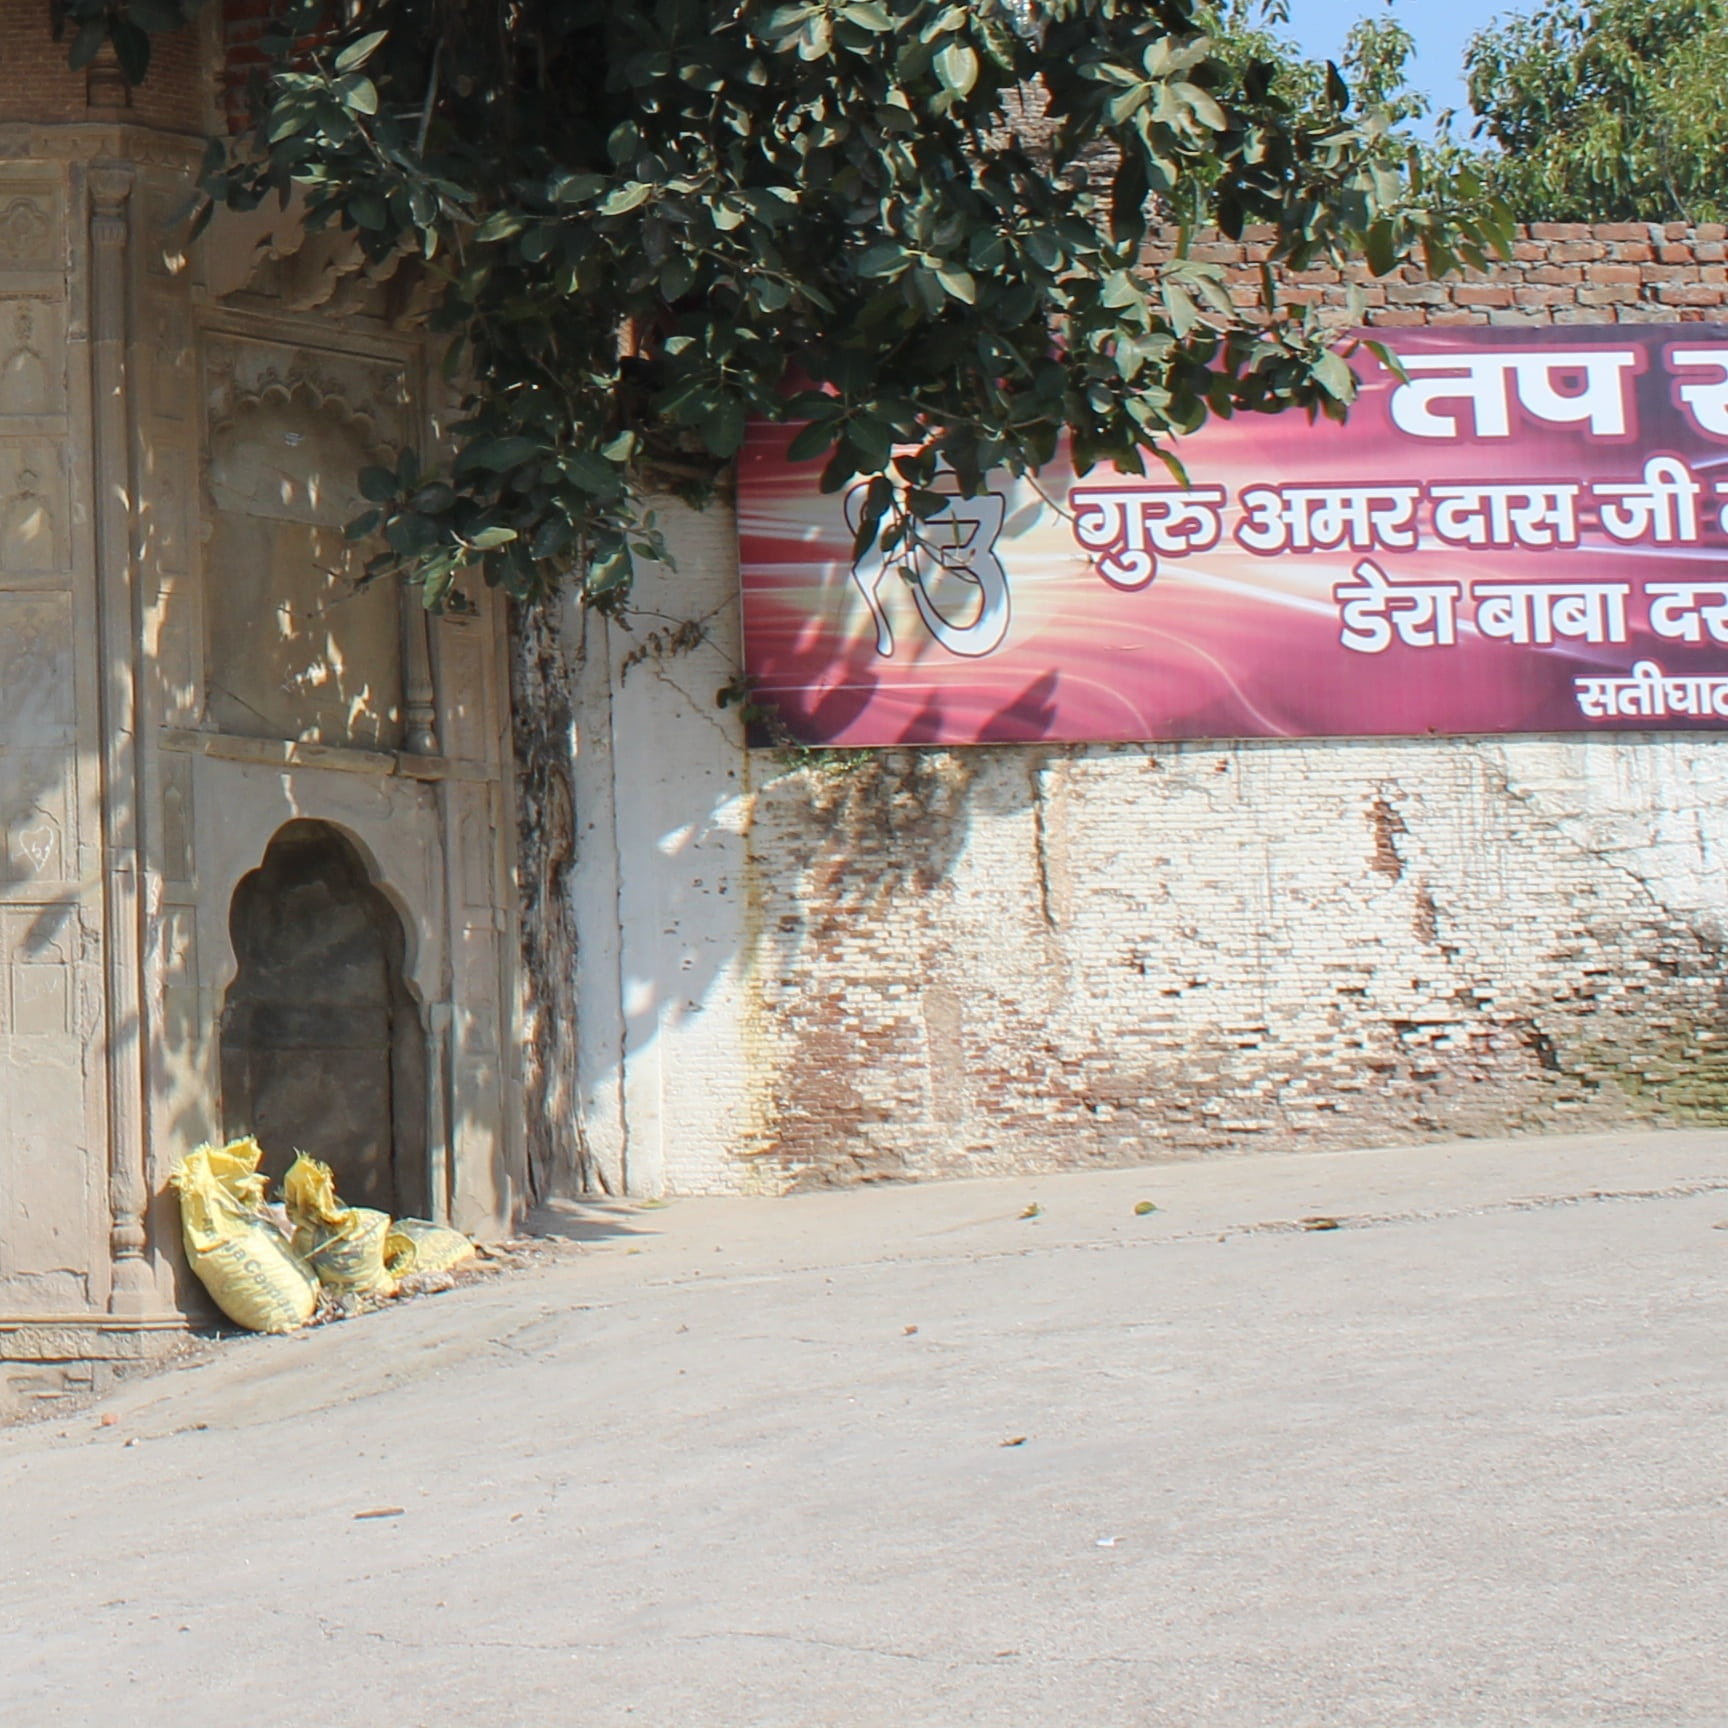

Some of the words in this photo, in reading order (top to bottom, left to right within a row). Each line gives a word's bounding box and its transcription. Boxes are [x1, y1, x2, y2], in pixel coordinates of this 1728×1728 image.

[1378, 349, 1636, 439] तप
[1073, 489, 1222, 587] गुरु
[1233, 485, 1420, 550] अमर
[1429, 483, 1580, 546] दास
[1591, 455, 1701, 542] जी
[1335, 559, 1460, 654] डेरा
[1473, 582, 1631, 645] बाबा
